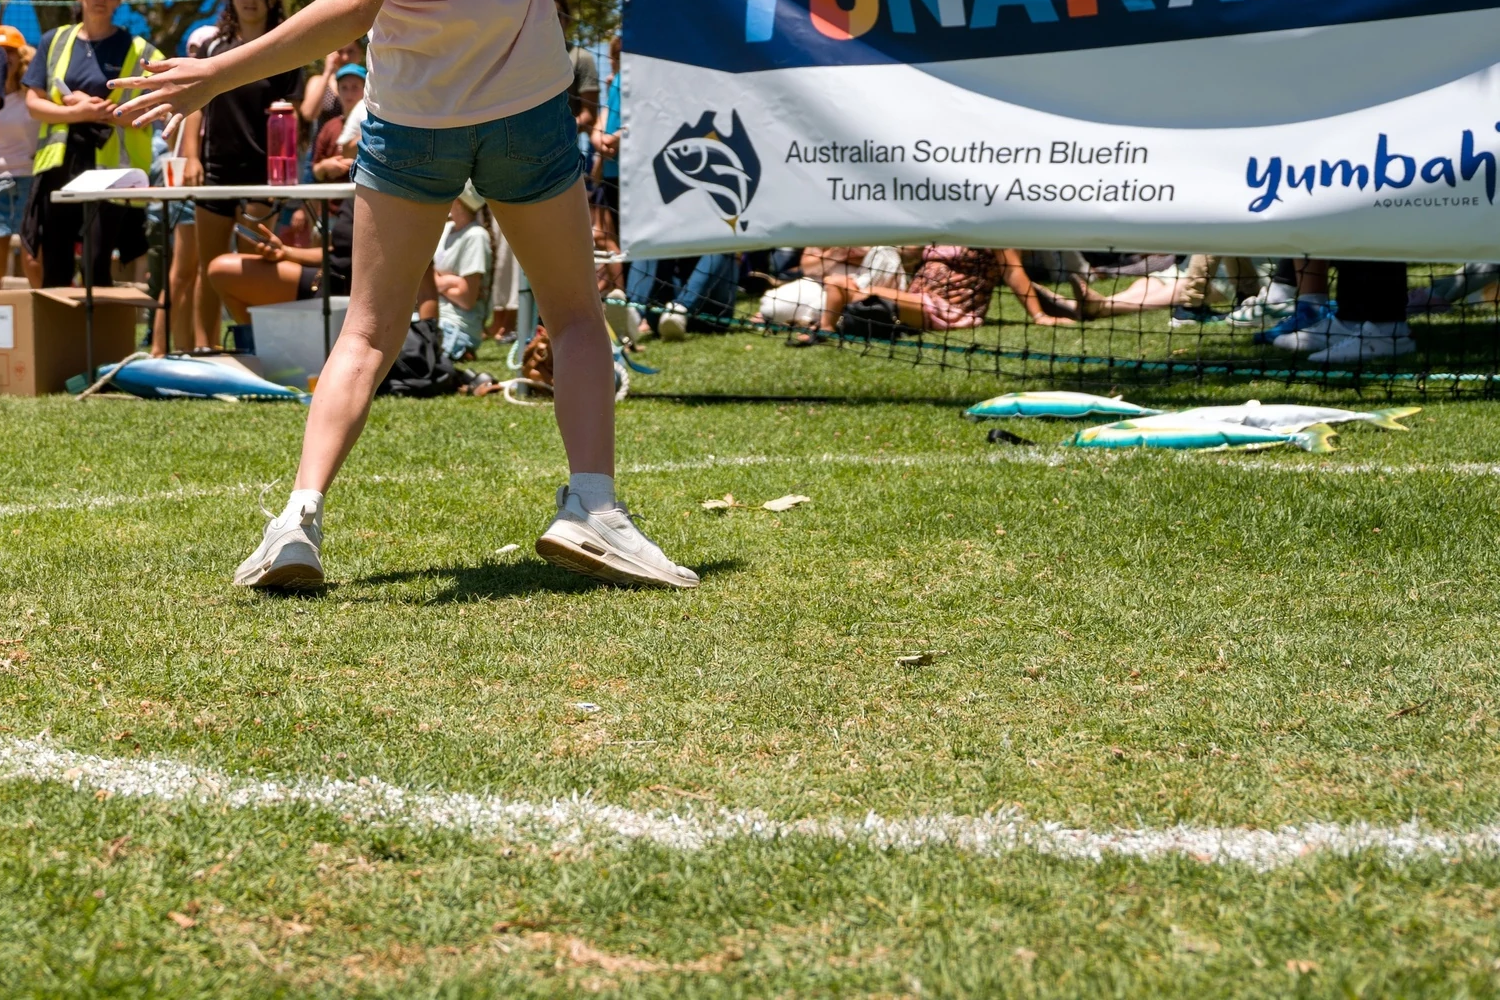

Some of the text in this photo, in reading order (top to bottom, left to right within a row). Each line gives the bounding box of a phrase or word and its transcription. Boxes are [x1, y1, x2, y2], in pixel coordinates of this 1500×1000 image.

[785, 139, 1149, 164] Australian Southern Bluefin
[1246, 129, 1497, 213] yumbah
[827, 177, 1175, 206] Tuna Industry Association
[1373, 196, 1480, 208] AQUACULTURE
